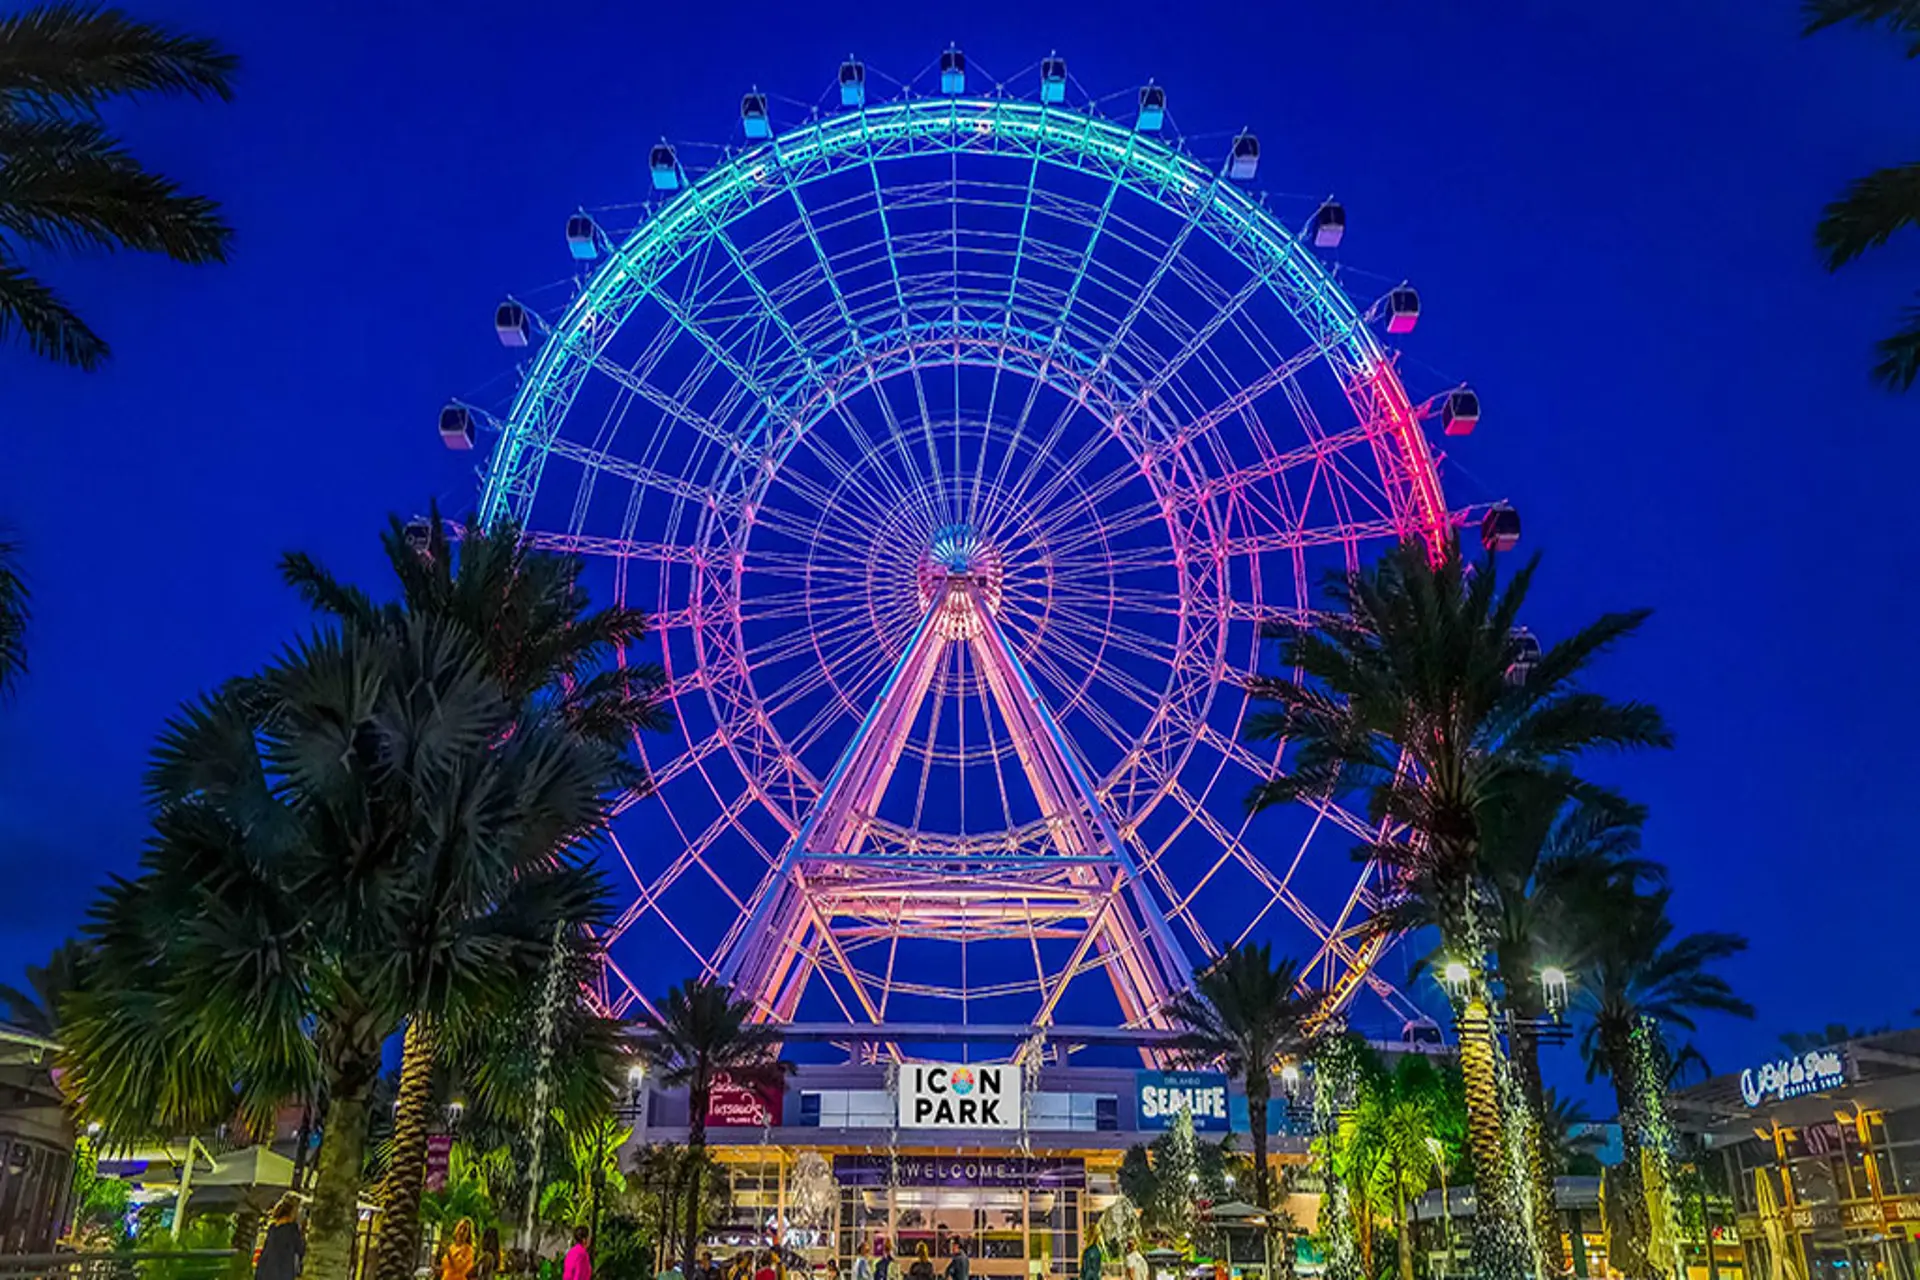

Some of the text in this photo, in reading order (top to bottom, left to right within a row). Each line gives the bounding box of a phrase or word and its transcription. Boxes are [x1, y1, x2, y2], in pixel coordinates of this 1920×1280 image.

[915, 1067, 1002, 1095] ICON
[914, 1097, 1001, 1124] PARK
[905, 1163, 1006, 1179] WELCOME
[1849, 1203, 1884, 1223] LUNCH
